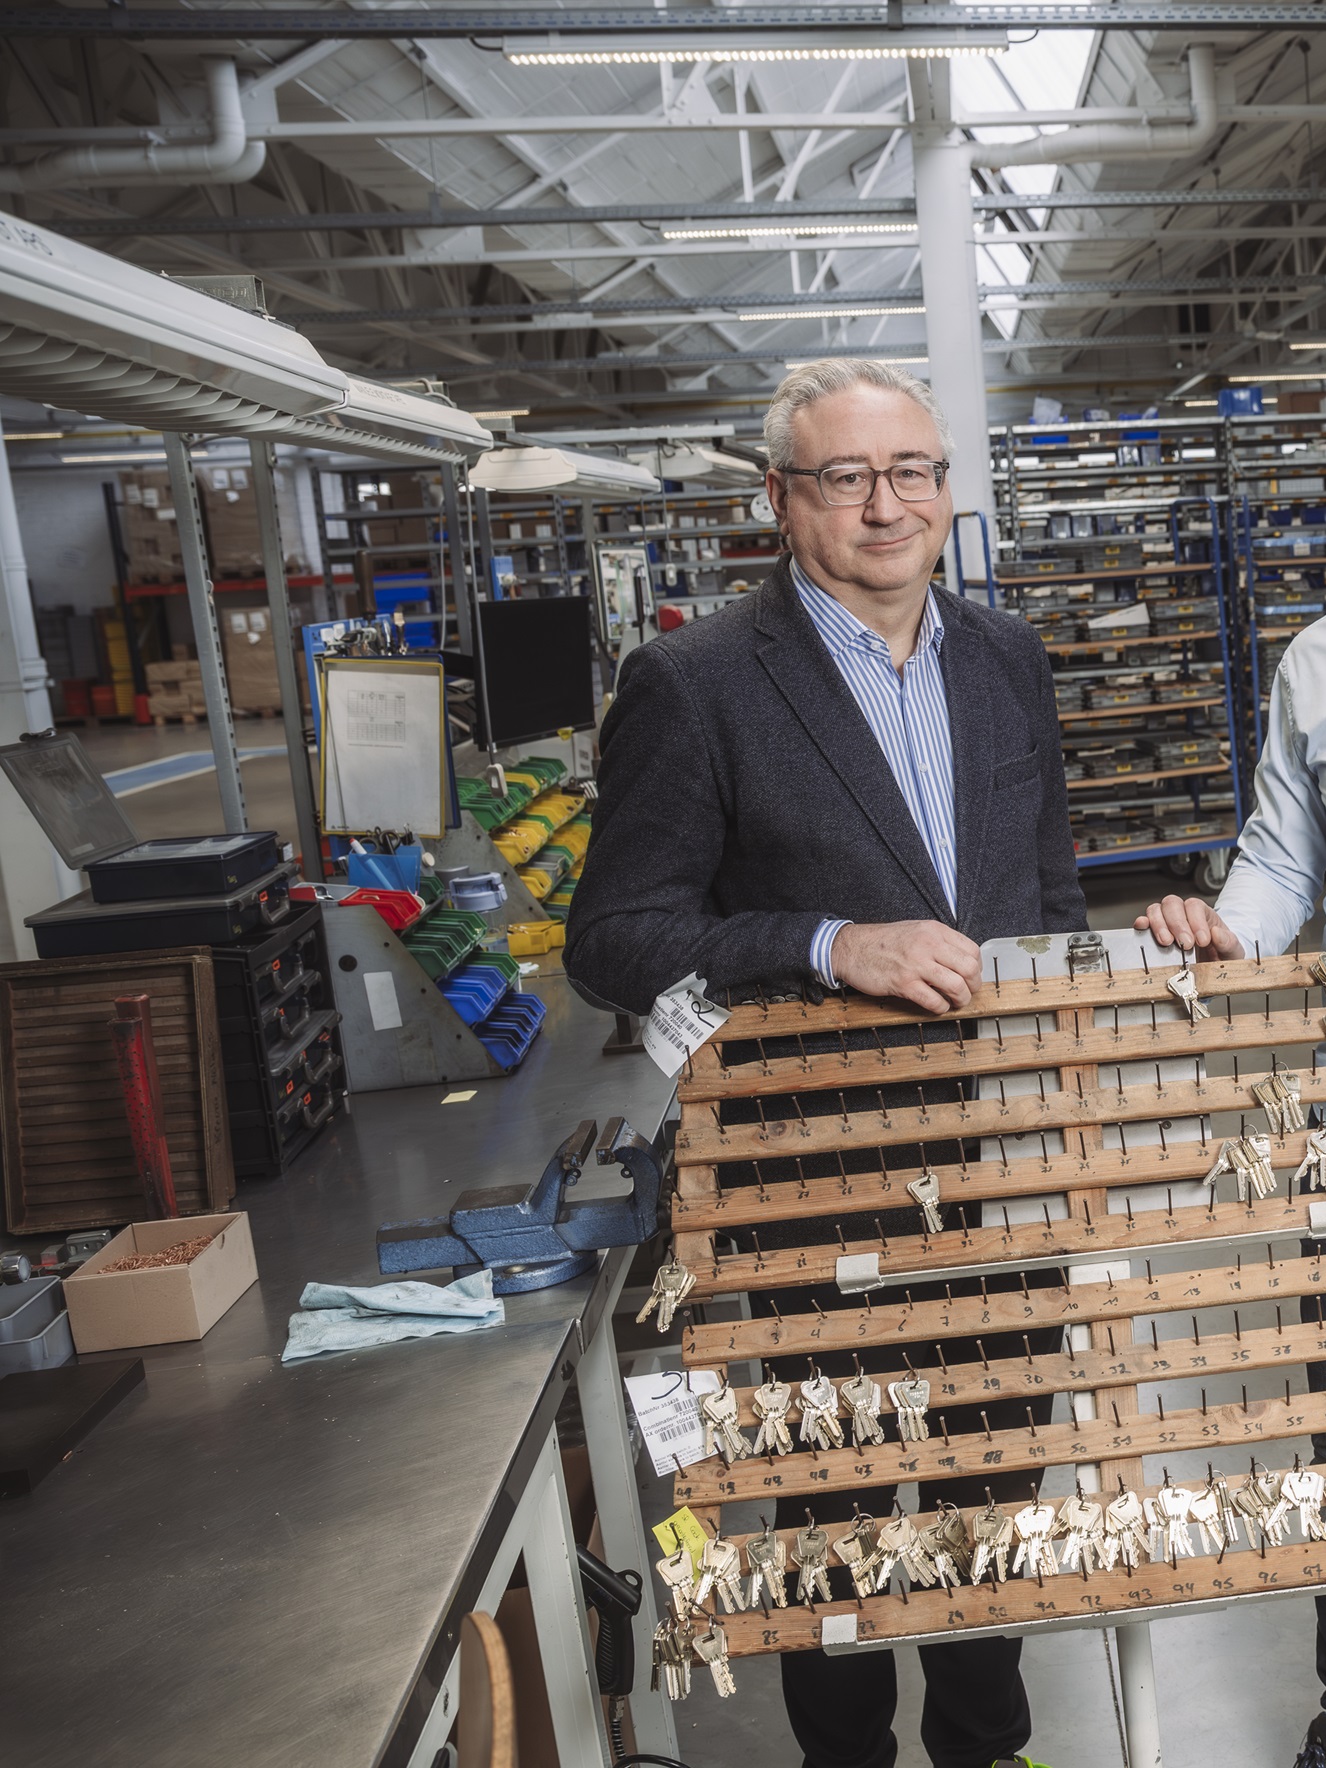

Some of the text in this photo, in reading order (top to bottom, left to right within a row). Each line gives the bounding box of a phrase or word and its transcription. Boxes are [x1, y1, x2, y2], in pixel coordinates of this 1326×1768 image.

[961, 1239, 974, 1248] 92
[1164, 1219, 1178, 1228] 97
[686, 1342, 696, 1354] 1
[728, 1337, 736, 1350] 2
[771, 1332, 780, 1345] 3
[811, 1328, 821, 1339] 4
[858, 1323, 867, 1335] 5
[897, 1319, 907, 1332] 6
[940, 1316, 950, 1327] 7
[981, 1310, 991, 1323] 8
[1024, 1306, 1034, 1318] 9
[1062, 1302, 1079, 1312] 10
[1103, 1297, 1119, 1305] 11
[1183, 1287, 1201, 1296] 13
[1024, 1373, 1044, 1384] 30
[1231, 1350, 1251, 1361] 35
[637, 1406, 660, 1417] BatchNr
[645, 1430, 654, 1438] AX
[1028, 1447, 1046, 1458] 49
[1071, 1442, 1087, 1454] 50
[1112, 1436, 1132, 1448] 51
[1158, 1431, 1177, 1442] 52
[1202, 1424, 1220, 1436] 53
[1244, 1422, 1263, 1435] 54
[1287, 1416, 1304, 1427] 55
[1080, 1595, 1102, 1608] 92
[1128, 1588, 1153, 1601] 93
[1173, 1582, 1195, 1594] 94
[1212, 1577, 1235, 1590] 95
[1258, 1571, 1279, 1584] 96
[1303, 1563, 1323, 1578] 97
